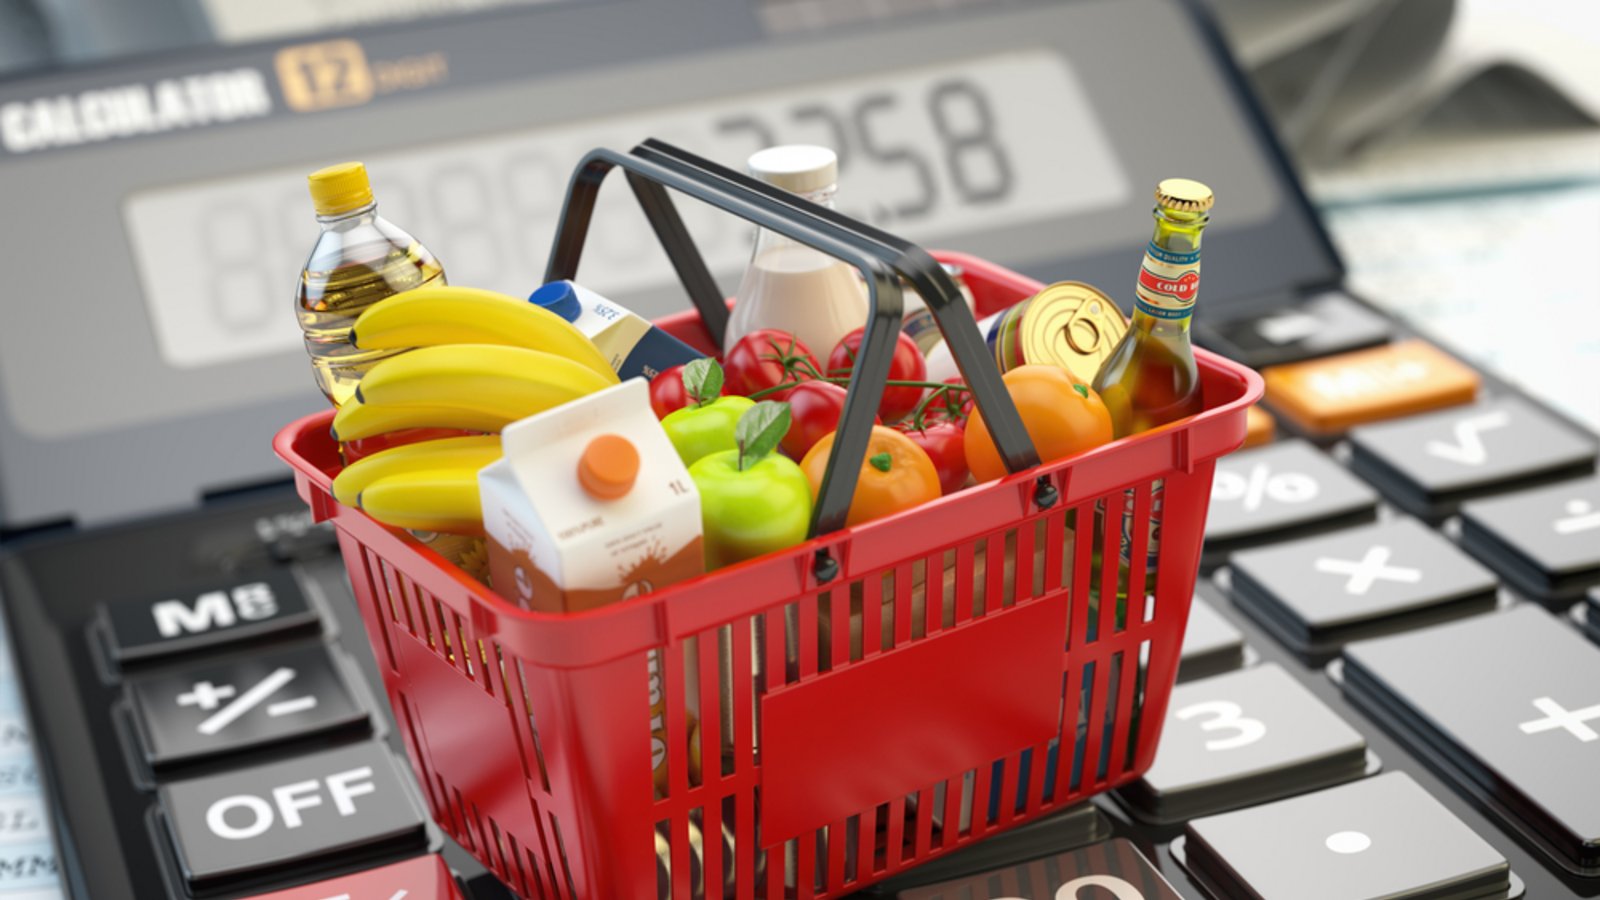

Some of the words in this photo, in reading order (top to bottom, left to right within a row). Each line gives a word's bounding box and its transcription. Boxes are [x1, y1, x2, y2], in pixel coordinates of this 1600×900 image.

[0, 68, 272, 152] CALCULATOR
[1156, 281, 1188, 292] COLD
[1174, 700, 1268, 751] 3
[205, 765, 376, 841] OFF
